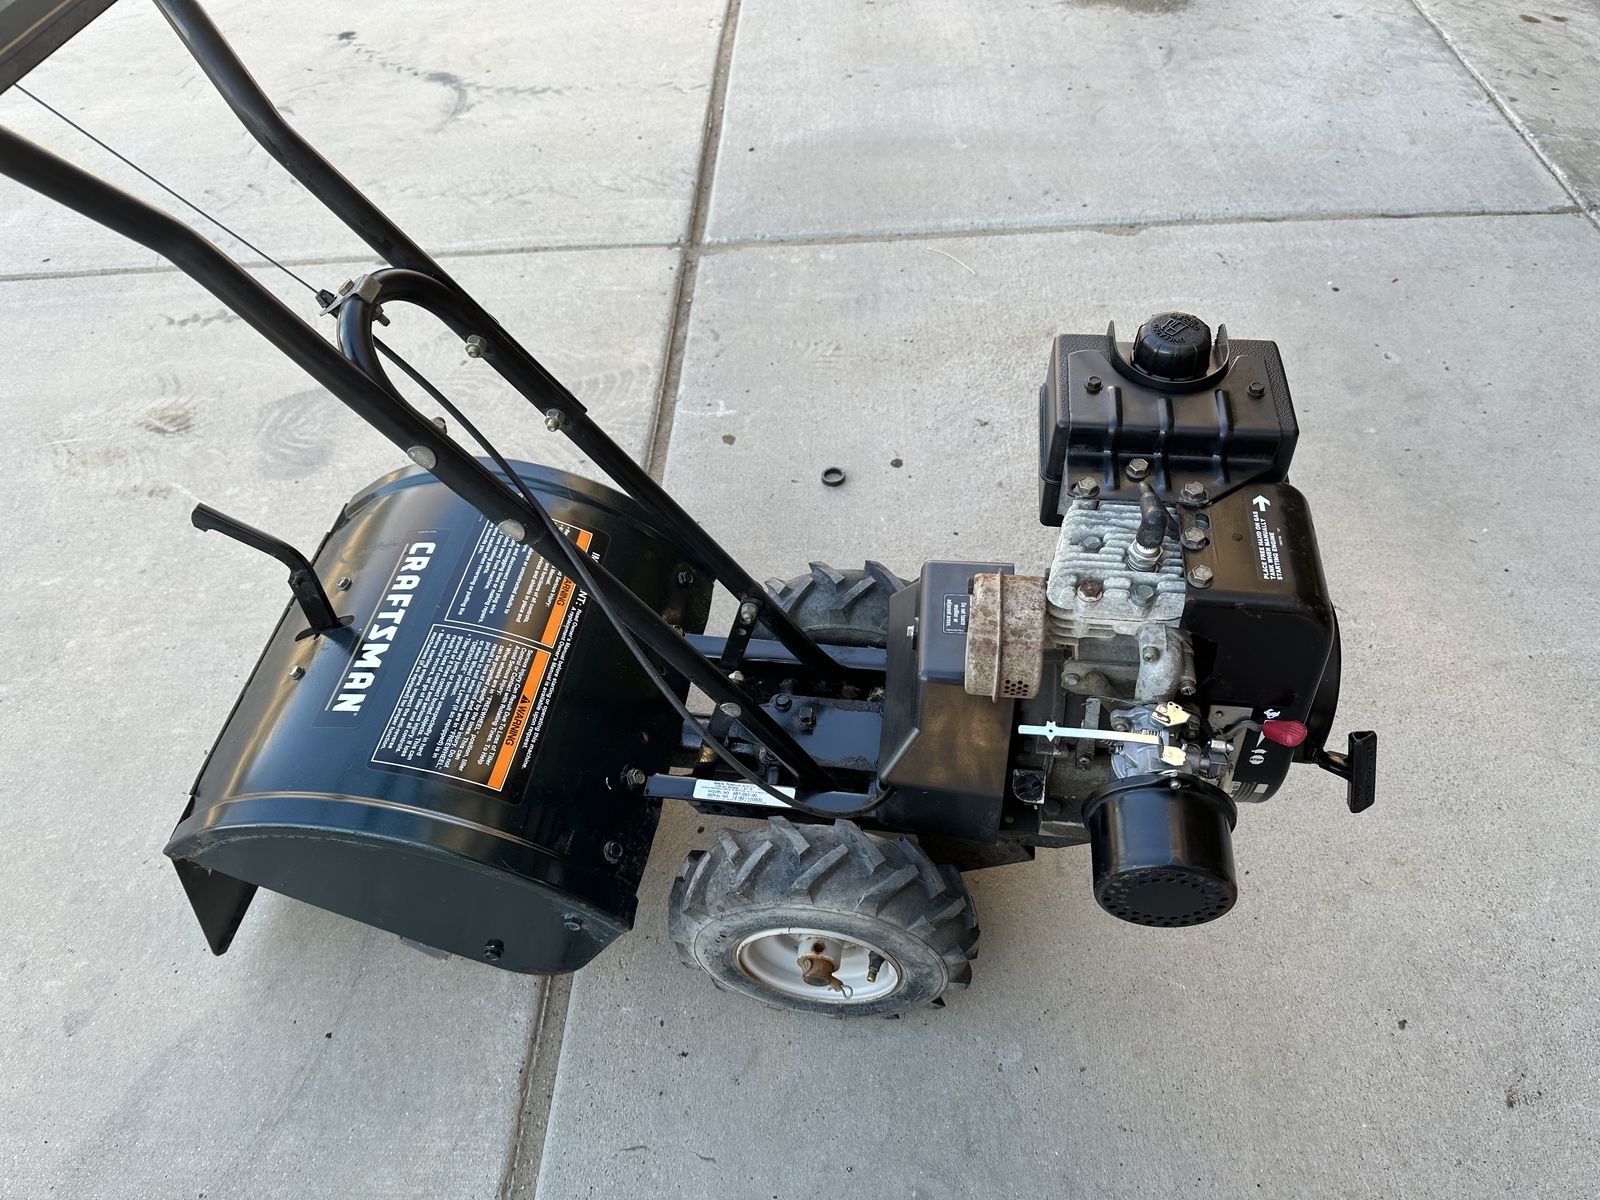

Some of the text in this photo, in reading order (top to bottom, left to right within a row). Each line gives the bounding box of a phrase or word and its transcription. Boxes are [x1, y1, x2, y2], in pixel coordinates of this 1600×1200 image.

[482, 528, 492, 545] towards
[1255, 522, 1261, 530] ON
[484, 537, 495, 553] caution
[495, 535, 503, 545] from
[1256, 531, 1264, 546] HAND
[1269, 532, 1278, 552] ENGINE
[479, 552, 488, 565] when
[487, 544, 499, 562] rotating
[1260, 519, 1276, 580] TANK WHEN MANUALLY
[470, 564, 483, 586] reversing
[484, 548, 504, 590] away from machine.
[1262, 561, 1270, 580] PLACE
[1273, 553, 1283, 580] STARTING
[477, 547, 513, 624] unclogging tines making repairs.
[489, 556, 516, 614] disconnect spark plug wire
[535, 571, 547, 592] functions
[545, 569, 556, 586] Manual.
[460, 591, 472, 607] pulling
[506, 594, 516, 609] adults
[518, 579, 536, 614] shields place
[544, 576, 562, 608] Serious Injury:
[556, 578, 573, 607] ARNING
[523, 603, 535, 624] controls.
[573, 608, 582, 622] Read
[332, 542, 436, 712] CRAFTSMAN
[560, 611, 575, 641] replacement
[567, 621, 578, 642] Owner's
[553, 640, 565, 661] Owner's
[560, 642, 571, 661] Manual
[449, 639, 479, 697] "DISENGAGE" position.
[483, 661, 498, 686] propelled
[495, 645, 521, 696] Avoid Serious Injury:
[546, 662, 557, 681] Manual
[554, 660, 564, 678] before
[436, 646, 483, 746] when Wheel Gear Lever equipped)
[476, 685, 489, 704] rapidly
[545, 677, 558, 698] starting
[443, 643, 499, 768] result loss control and serious injury. not
[458, 647, 512, 772] When wheels "FREEWHEEL" position, tiller
[476, 647, 527, 766] Control Contact with Rotating Tines. Help
[485, 649, 534, 766] Serious Injury Can Result Due Loss Tiller
[536, 687, 548, 711] available
[434, 651, 489, 770] tines soil when wheels "FREEWHEEL,"
[470, 711, 479, 721] the
[529, 711, 539, 726] upon
[534, 705, 548, 732] operating
[464, 721, 475, 736] tines.
[504, 705, 527, 747] WARNING
[459, 737, 468, 749] This
[521, 726, 534, 749] request.
[531, 732, 539, 743] this
[454, 749, 462, 760] can
[521, 743, 535, 770] machine.
